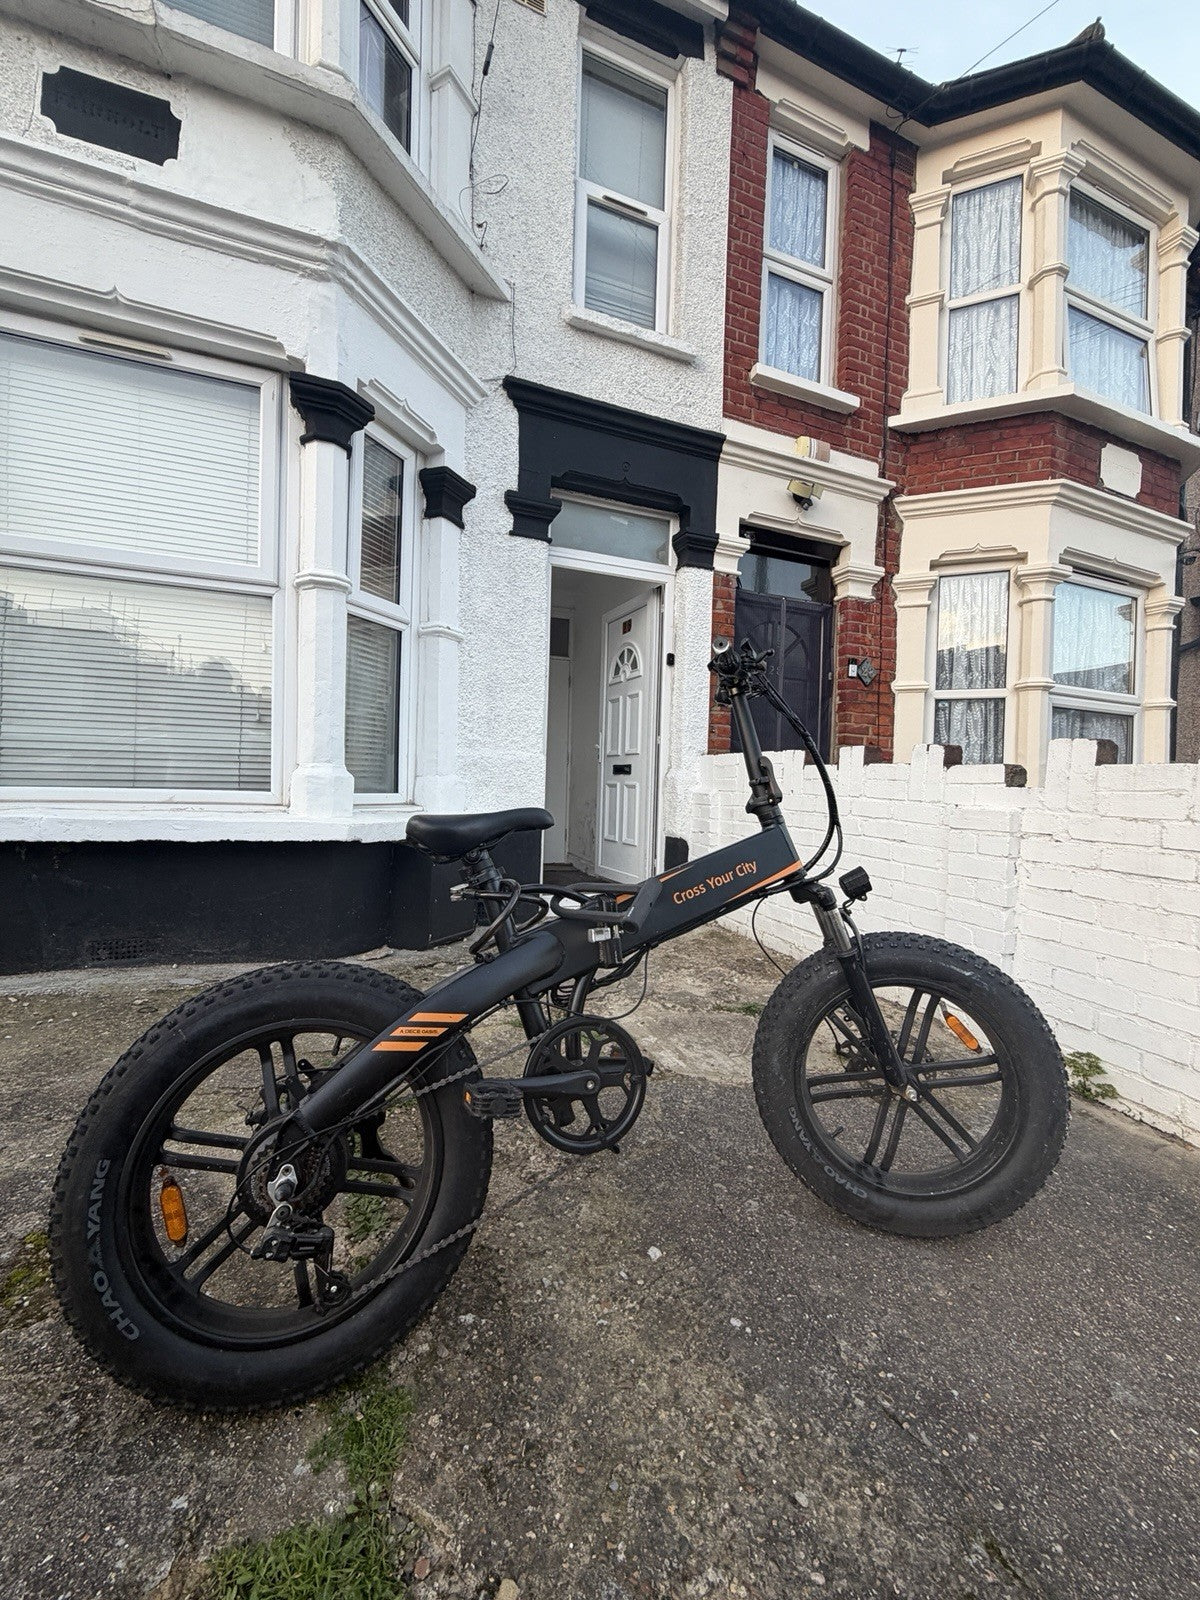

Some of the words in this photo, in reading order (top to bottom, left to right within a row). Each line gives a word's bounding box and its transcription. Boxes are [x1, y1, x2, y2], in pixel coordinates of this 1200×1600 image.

[673, 883, 707, 904] Cross
[706, 870, 734, 889] Your
[735, 861, 757, 877] City
